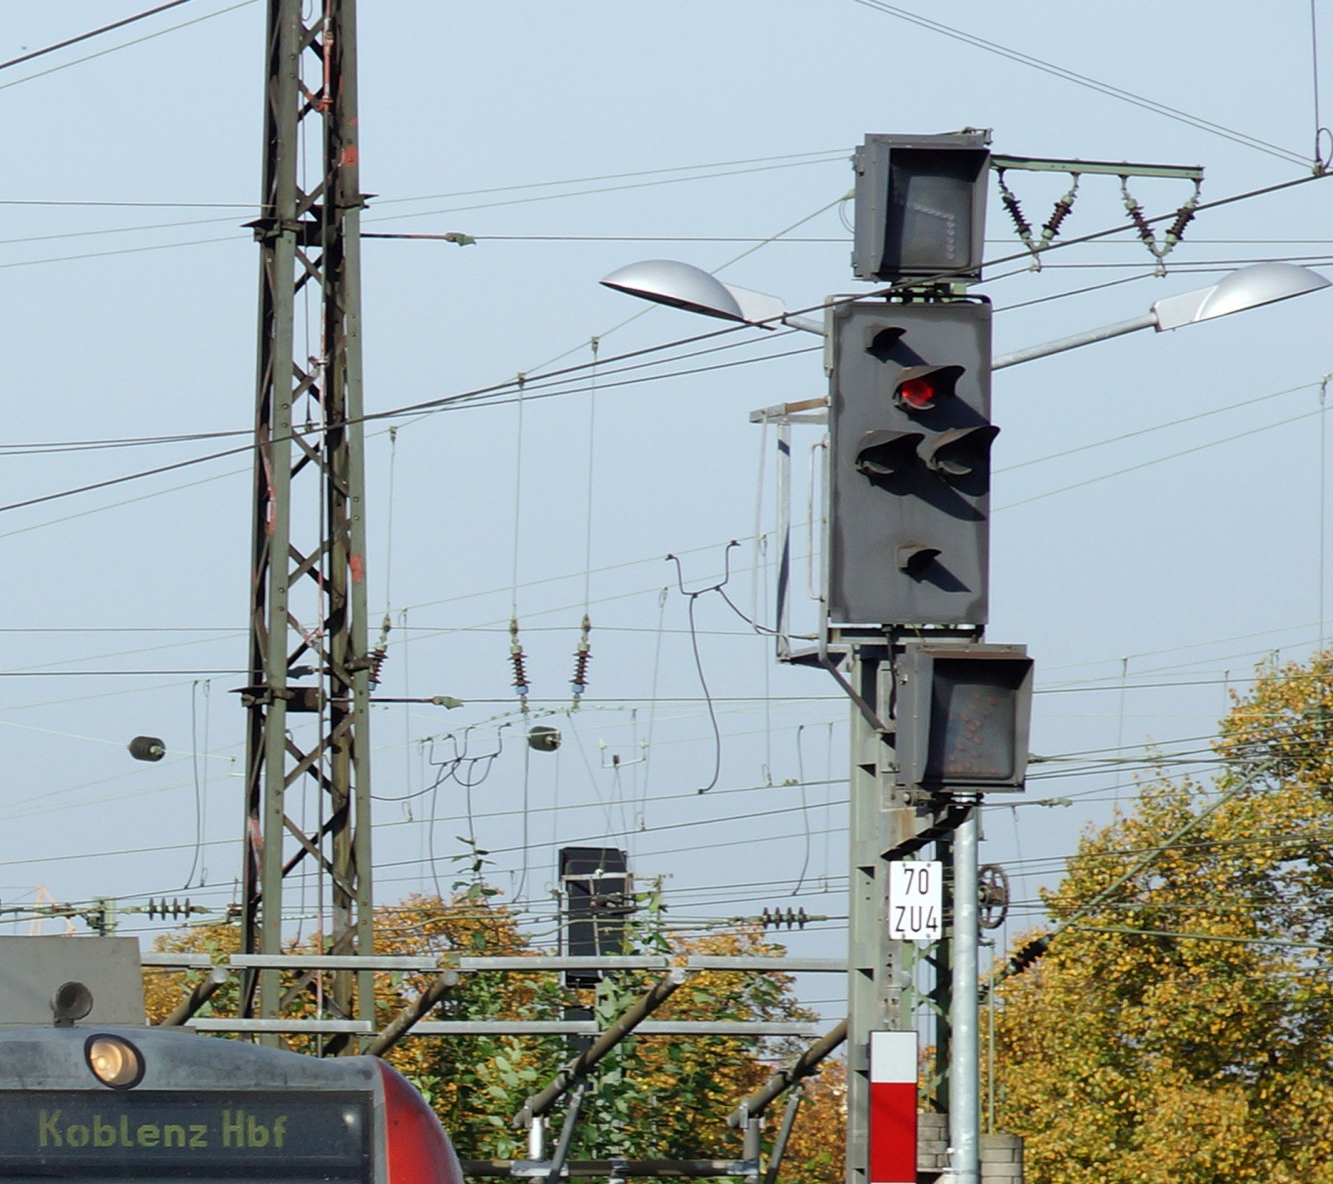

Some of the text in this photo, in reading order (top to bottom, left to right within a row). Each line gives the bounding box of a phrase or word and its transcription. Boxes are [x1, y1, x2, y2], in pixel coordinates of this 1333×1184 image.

[904, 868, 929, 895] 70
[895, 905, 939, 932] ZU4
[38, 1109, 209, 1149] Koblenz
[221, 1108, 288, 1149] Hbf
